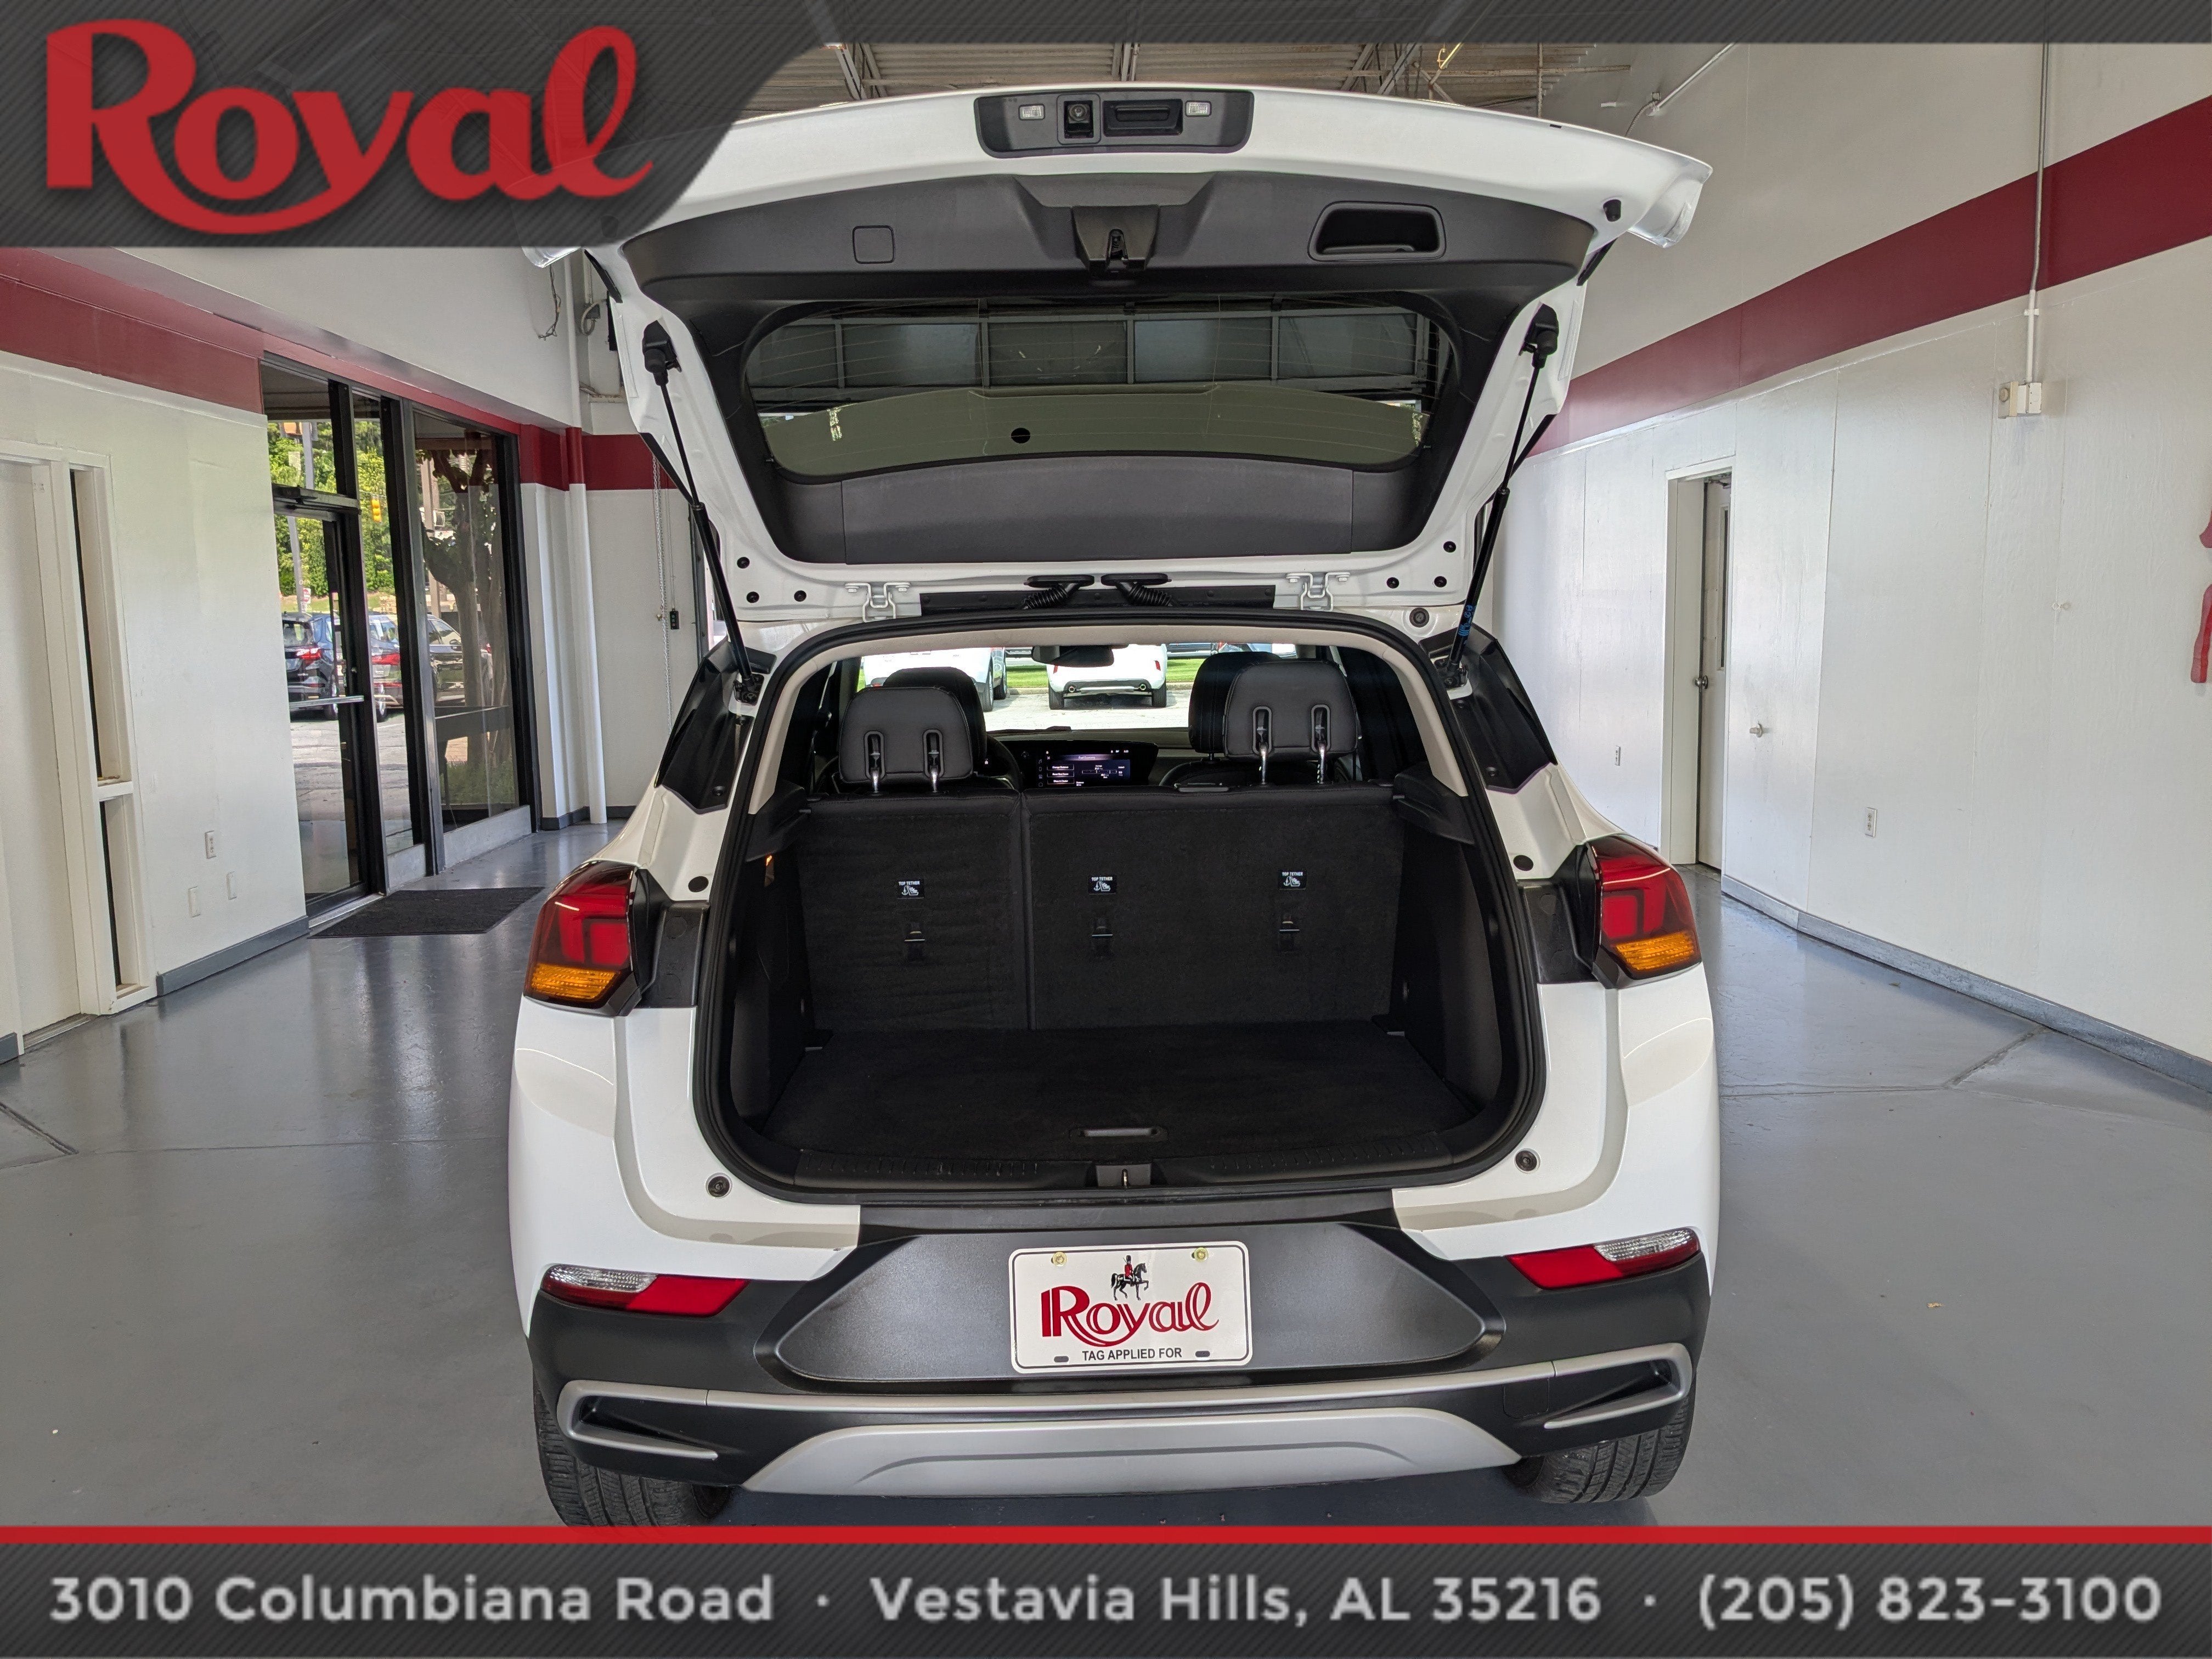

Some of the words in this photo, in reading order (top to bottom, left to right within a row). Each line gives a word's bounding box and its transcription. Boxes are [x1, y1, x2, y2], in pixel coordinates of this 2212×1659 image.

[1041, 1282, 1220, 1347] Royal
[1082, 1350, 1105, 1361] TAG
[1108, 1348, 1155, 1360] APPLIED
[1159, 1347, 1182, 1358] FOR
